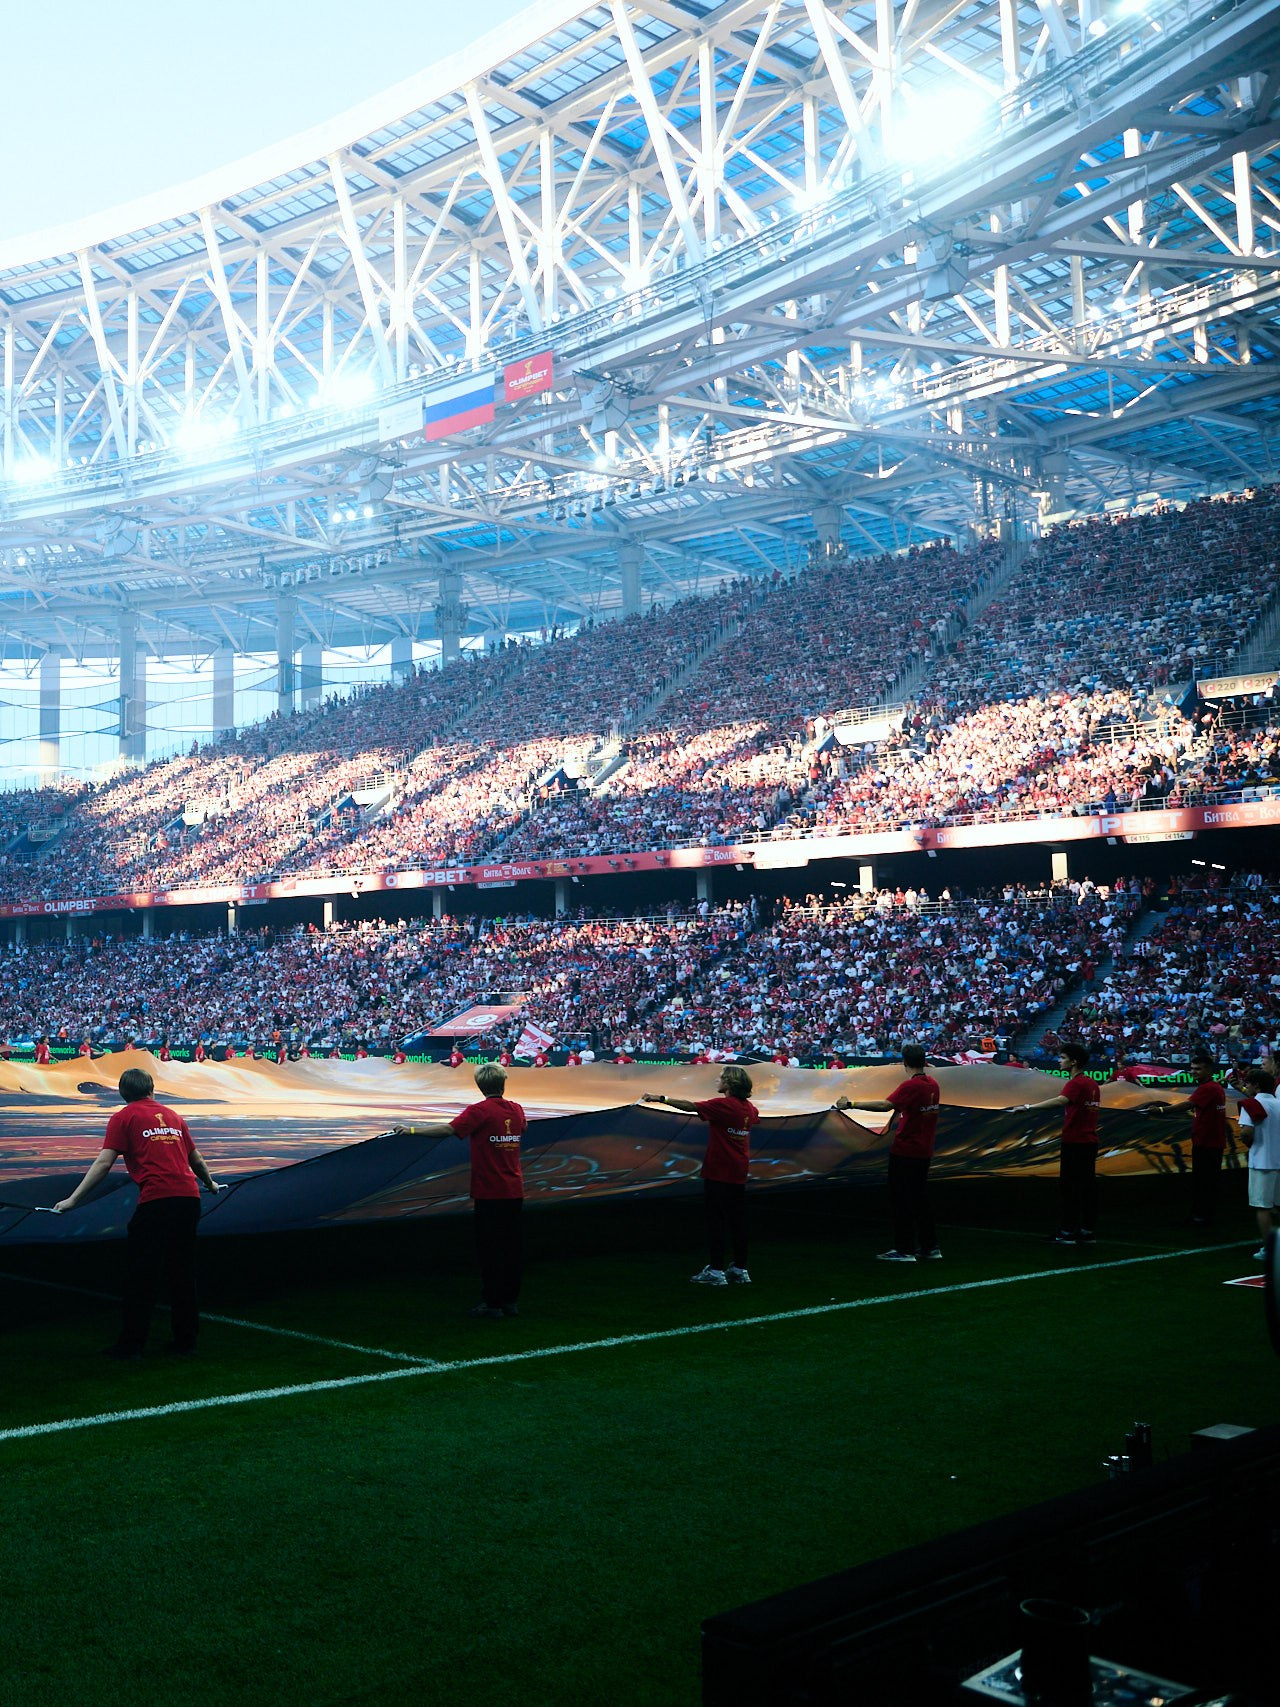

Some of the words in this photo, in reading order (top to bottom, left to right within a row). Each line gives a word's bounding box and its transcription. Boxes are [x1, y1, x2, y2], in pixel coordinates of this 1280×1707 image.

[509, 369, 548, 388] OLIMPBET
[1218, 682, 1236, 691] 220
[44, 899, 96, 912] OLIMPBET
[142, 1127, 182, 1138] OLIMPBET
[489, 1135, 521, 1143] OLIMPBE
